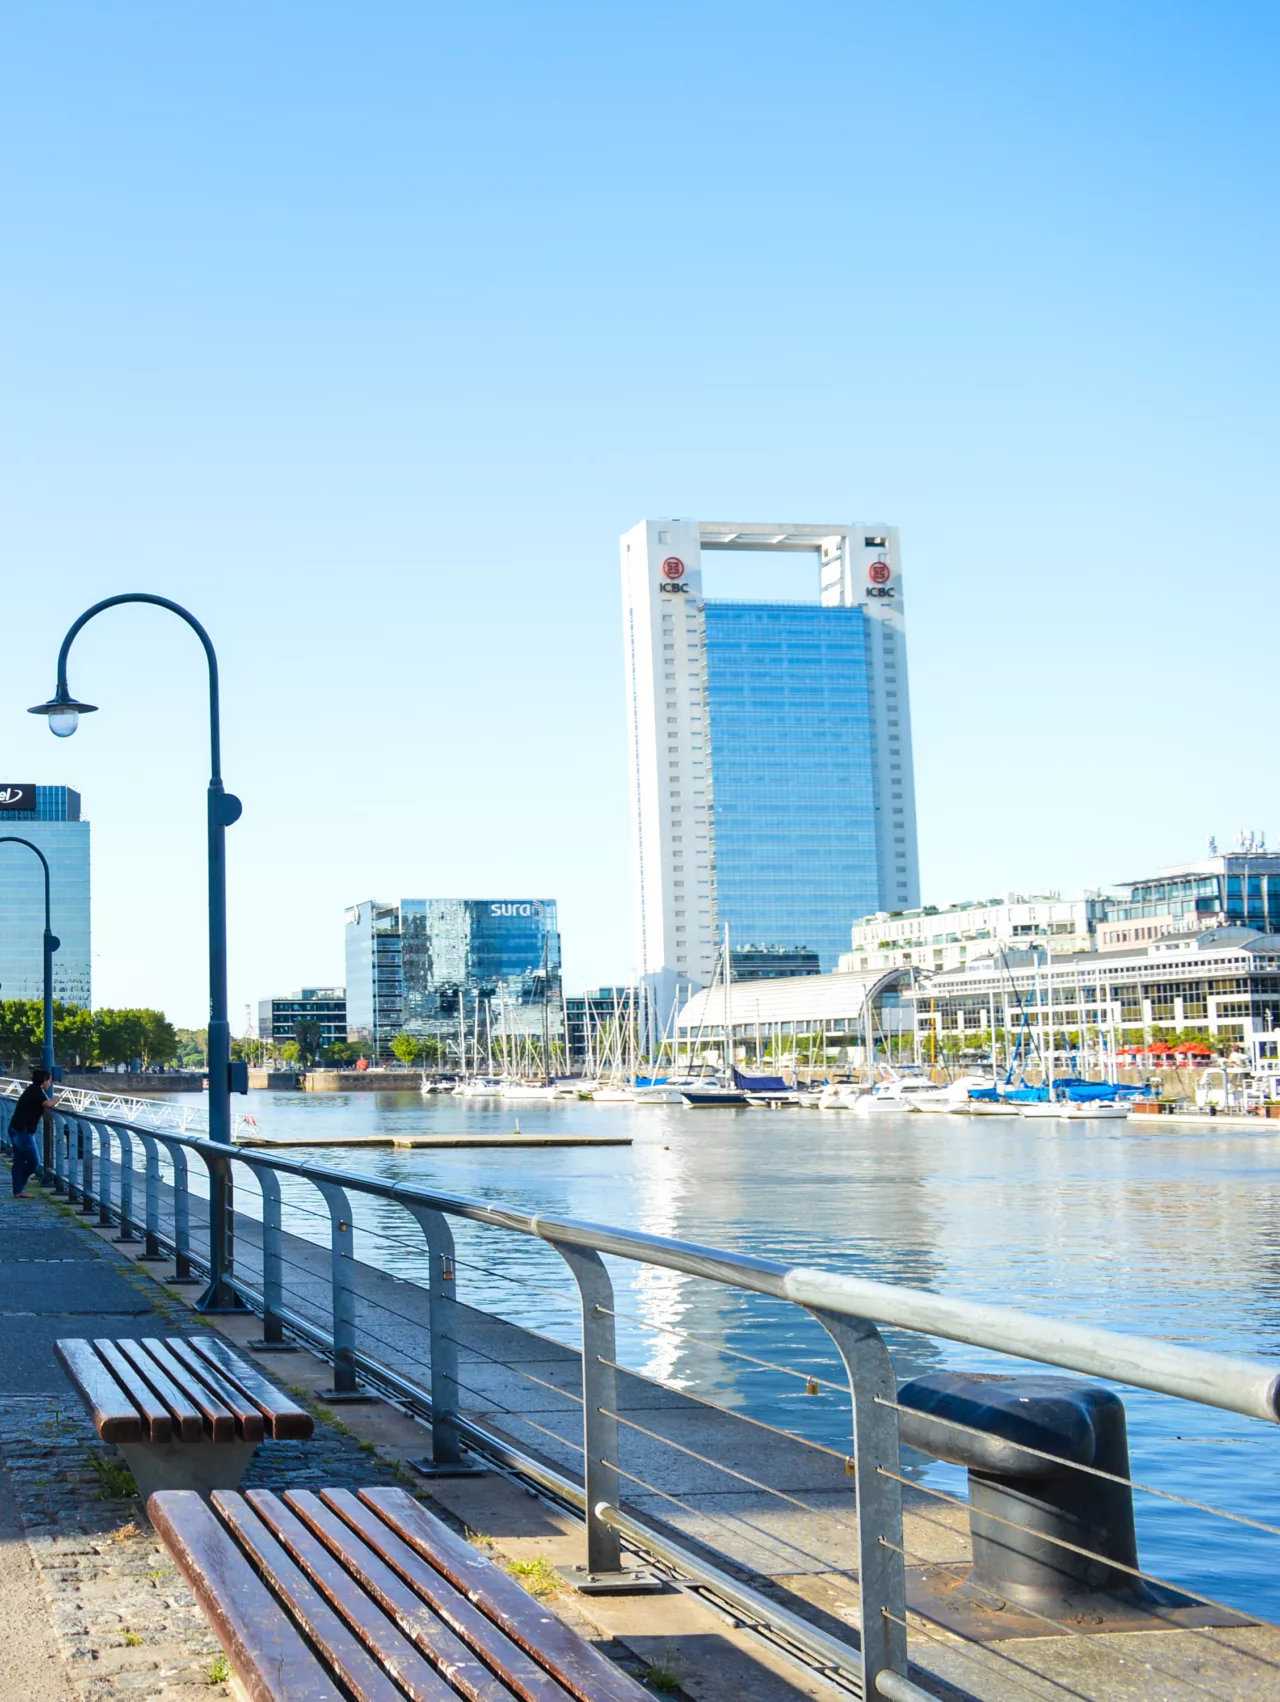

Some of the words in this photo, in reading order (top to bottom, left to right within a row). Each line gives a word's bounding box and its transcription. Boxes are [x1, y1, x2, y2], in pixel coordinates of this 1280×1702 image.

[659, 583, 689, 592] ICBC
[866, 587, 895, 597] ICBC
[491, 904, 531, 916] sura
